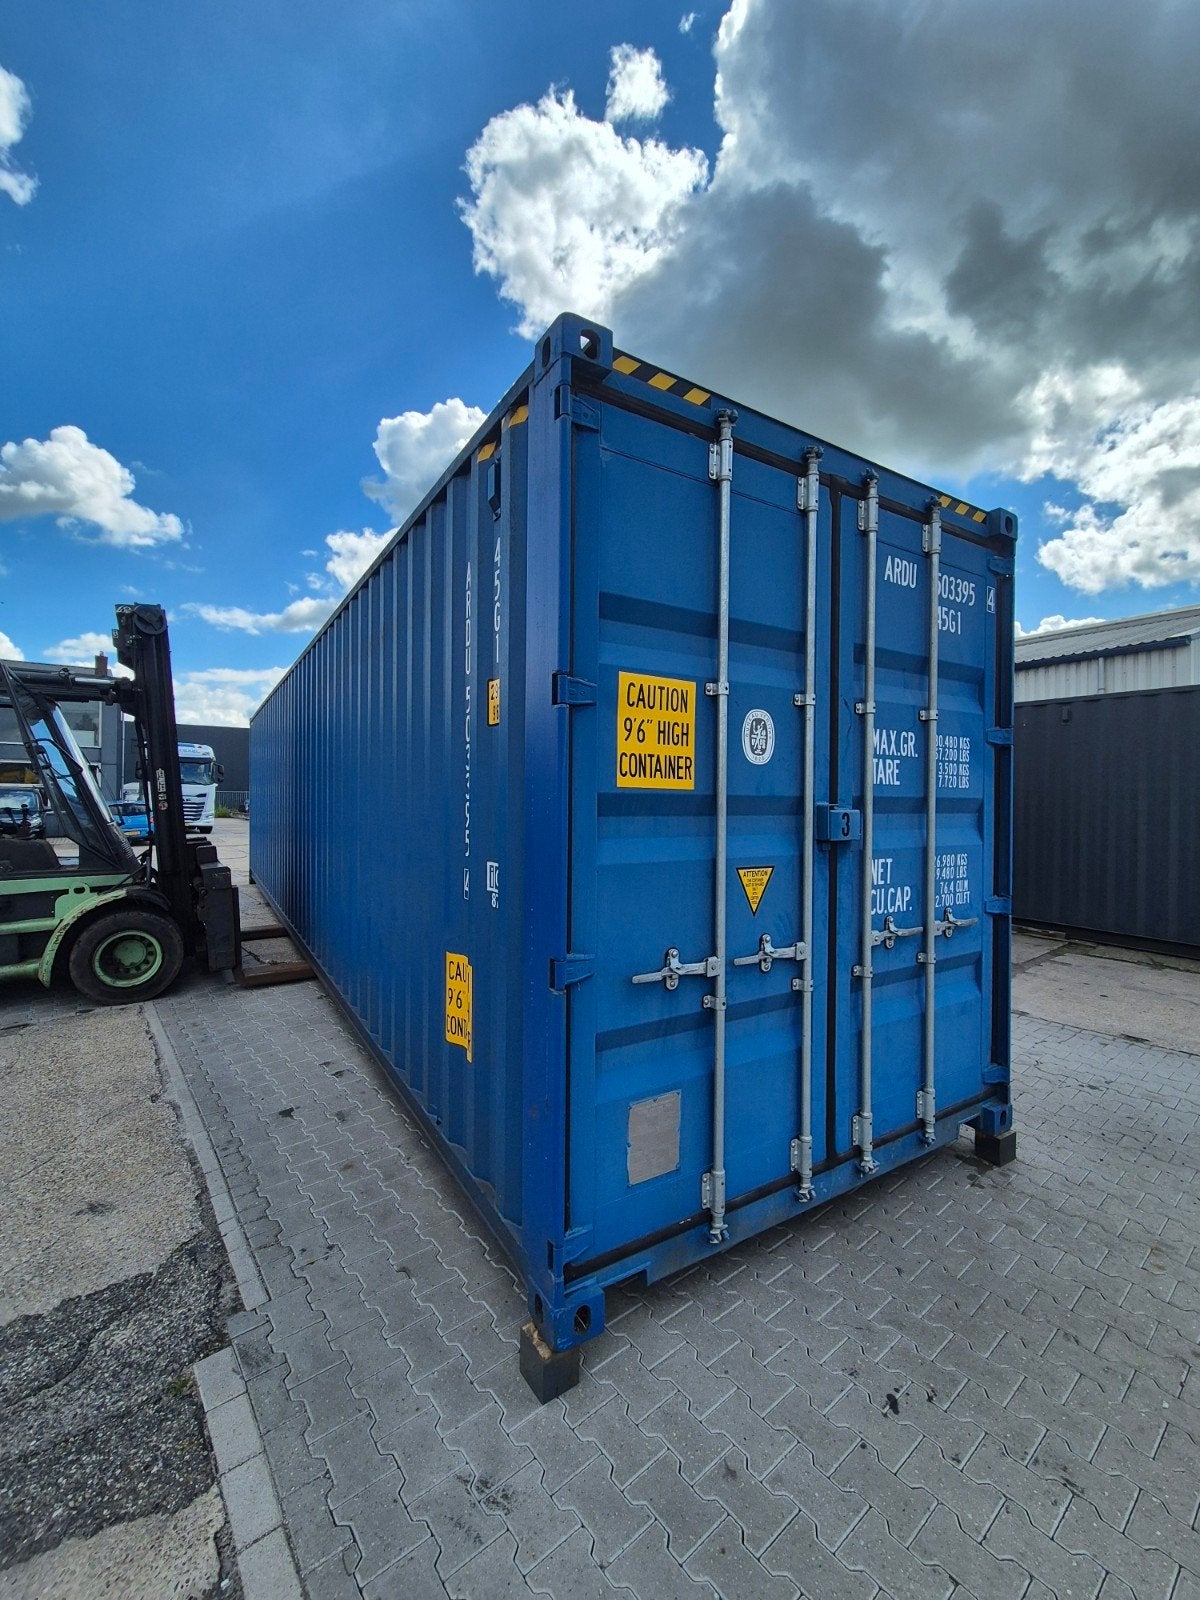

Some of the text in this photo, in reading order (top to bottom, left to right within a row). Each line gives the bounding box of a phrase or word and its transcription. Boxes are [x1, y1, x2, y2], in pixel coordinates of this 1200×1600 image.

[884, 555, 917, 589] ARDU
[987, 588, 995, 613] 4
[626, 682, 689, 714] CAUTION
[657, 720, 690, 747] HIGH
[873, 728, 919, 758] MAX.GR.
[619, 752, 693, 780] CONTAINER
[873, 758, 900, 786] TARE
[958, 775, 970, 789] LBS
[841, 812, 851, 837] 3
[742, 870, 768, 878] ATTENTION
[872, 858, 893, 886] NET
[934, 854, 955, 868] 6.980
[956, 866, 967, 879] LBS
[871, 886, 912, 915] CU.CAP.
[935, 893, 954, 908] 2.700
